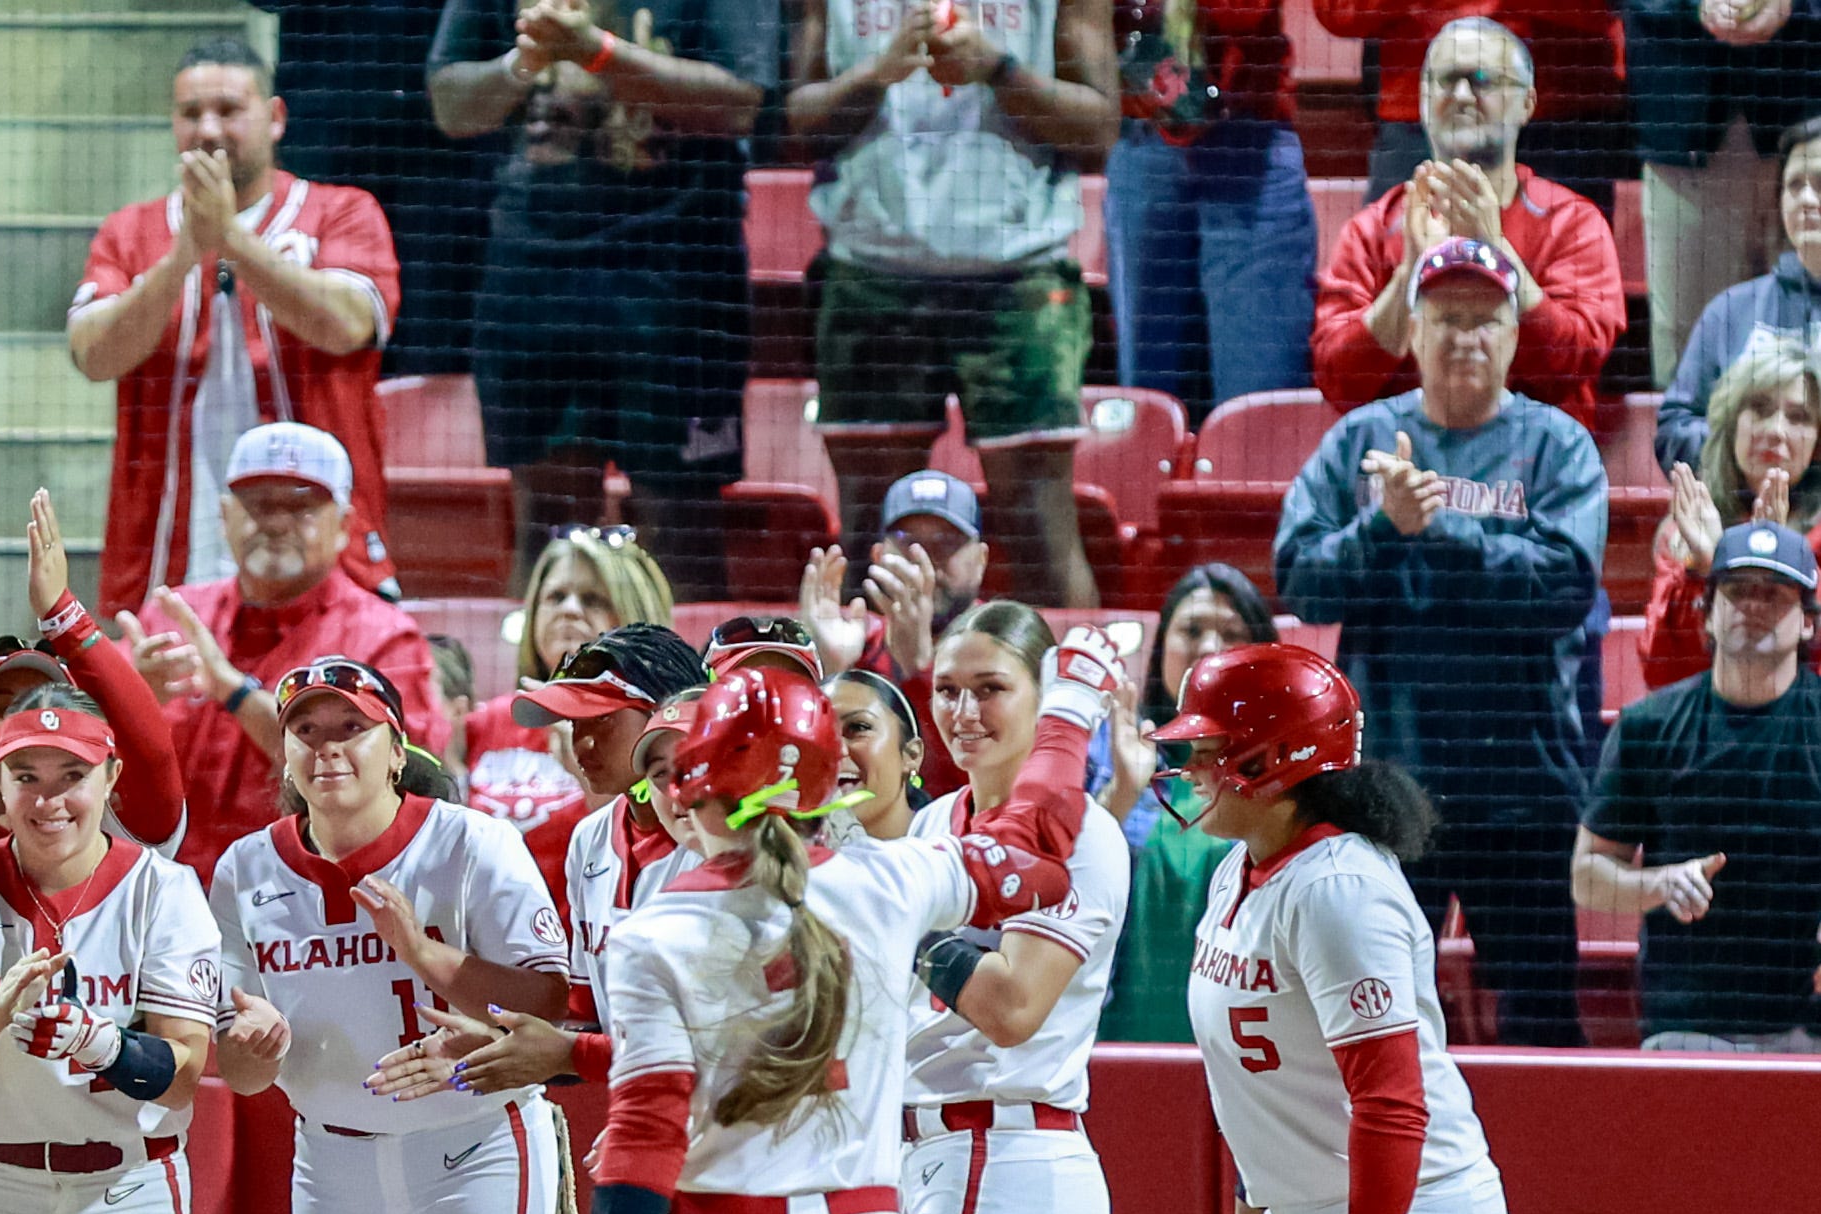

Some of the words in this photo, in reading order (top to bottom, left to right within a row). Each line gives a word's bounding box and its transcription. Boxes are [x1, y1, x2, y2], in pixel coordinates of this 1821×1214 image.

[188, 959, 219, 999] SEC
[1349, 977, 1393, 1019] SEC
[1228, 1006, 1281, 1074] 5
